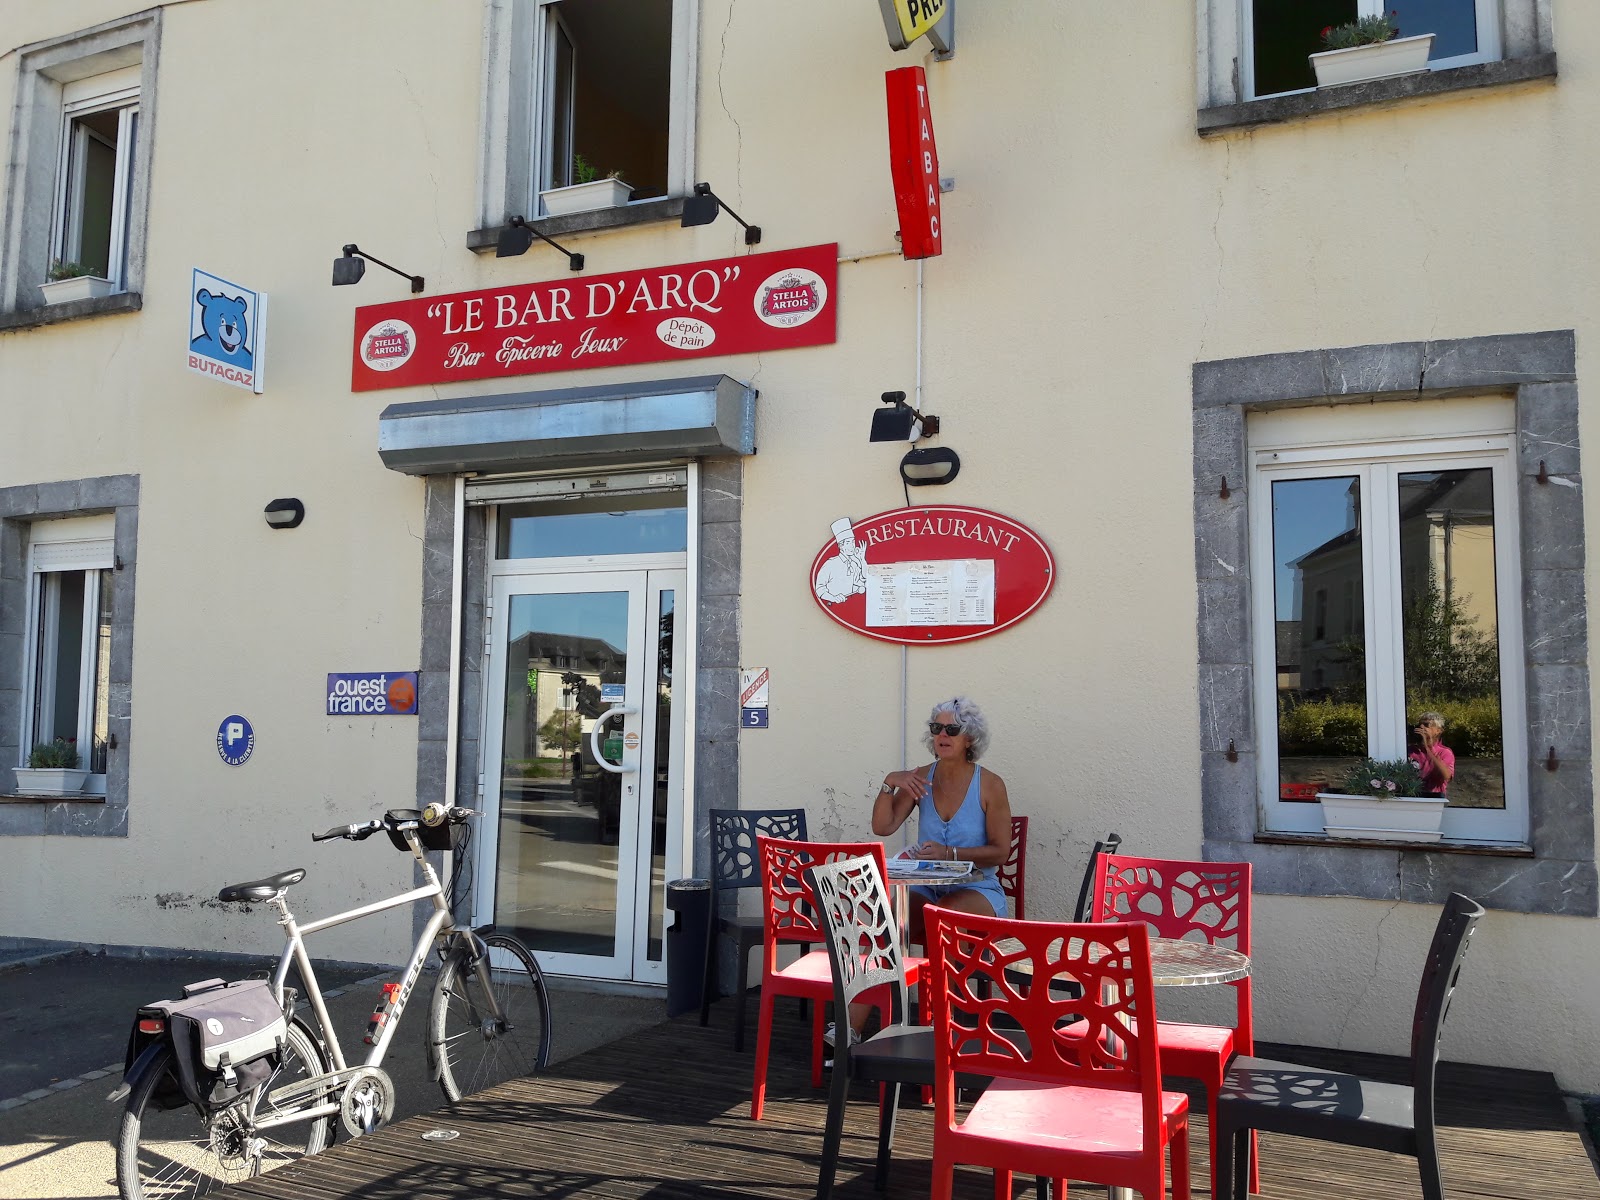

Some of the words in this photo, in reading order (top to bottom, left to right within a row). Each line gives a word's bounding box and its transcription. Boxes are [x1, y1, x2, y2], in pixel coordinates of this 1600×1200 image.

[917, 84, 939, 239] TABAC
[772, 289, 808, 301] STELLA
[772, 298, 809, 310] ARTOIS
[494, 287, 576, 329] BAR
[669, 319, 705, 336] Dépôt
[374, 337, 402, 348] STELLA
[374, 345, 402, 355] ARTOIS
[443, 342, 485, 369] Bar
[571, 326, 628, 359] Jeux
[663, 332, 677, 343] de
[679, 334, 705, 347] pain
[188, 355, 253, 387] BUTAGAZ
[865, 517, 1021, 553] RESTAURANT
[334, 674, 387, 695] ouest
[743, 671, 767, 703] LICENCE
[328, 692, 387, 713] france
[750, 711, 760, 725] 5
